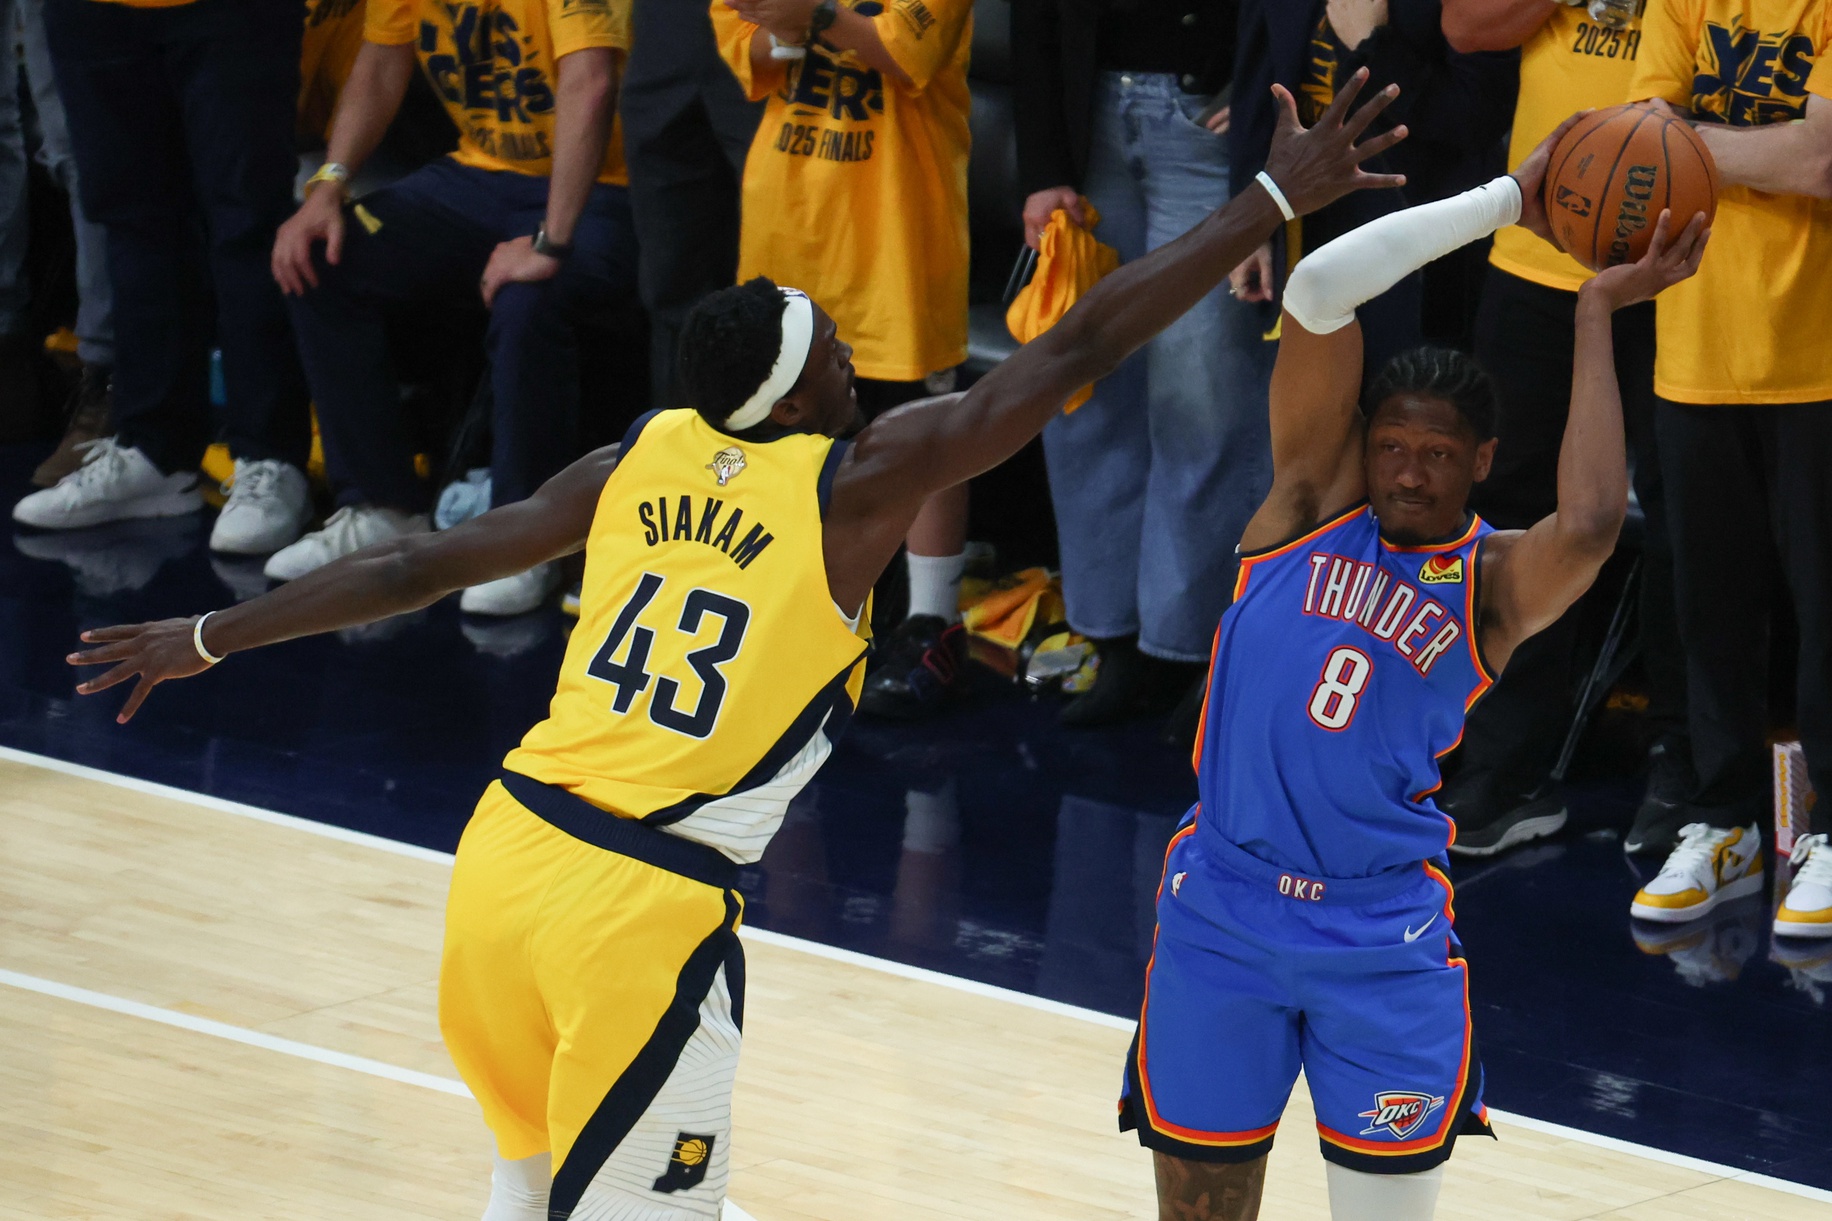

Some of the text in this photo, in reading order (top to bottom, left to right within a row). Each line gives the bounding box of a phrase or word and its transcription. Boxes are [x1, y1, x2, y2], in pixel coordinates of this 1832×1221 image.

[1573, 22, 1625, 58] 2025
[1705, 20, 1814, 97] YES
[775, 121, 874, 162] 025 FINALS
[638, 495, 775, 571] SIAKAM
[1302, 552, 1462, 678] THUNDER
[585, 571, 752, 740] 43
[1306, 645, 1374, 733] 8
[1278, 873, 1326, 902] OKC
[1374, 1101, 1421, 1126] OKC
